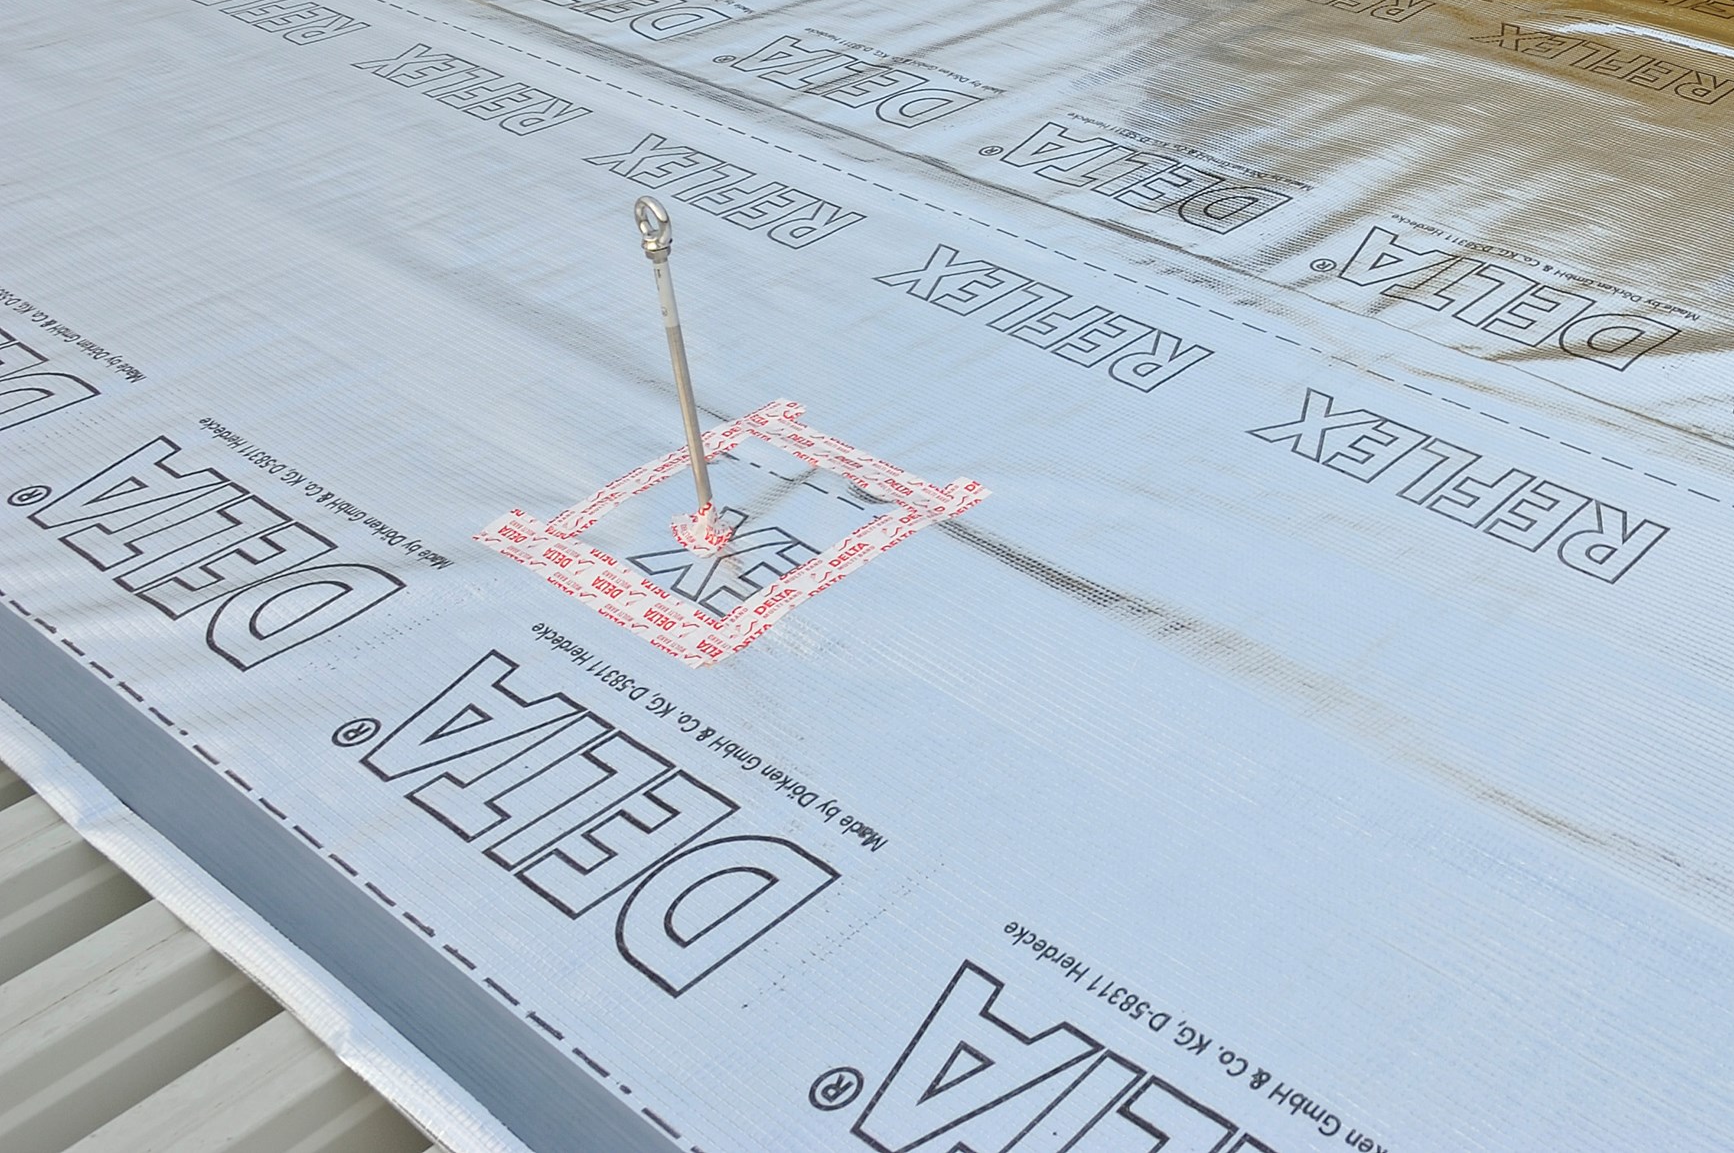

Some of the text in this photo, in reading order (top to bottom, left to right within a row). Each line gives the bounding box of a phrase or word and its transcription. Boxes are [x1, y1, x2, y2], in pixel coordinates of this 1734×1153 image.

[351, 43, 593, 136] REFLEX
[583, 133, 867, 249] REFLEX
[1391, 214, 1444, 237] Herdecke
[1554, 268, 1595, 288] GmbH
[1643, 297, 1663, 310] by
[1662, 303, 1701, 323] Made
[873, 244, 1214, 392] REFLEX
[104, 355, 123, 369] by
[199, 417, 248, 449] Herdecke
[305, 481, 324, 497] Co.
[1246, 387, 1671, 584] REFLEX
[316, 492, 335, 503] &
[325, 498, 367, 522] GmbH
[363, 517, 407, 546] Dörken
[498, 526, 528, 543] DELTA
[401, 539, 422, 555] by
[542, 548, 573, 568] DELTA
[829, 543, 869, 567] DELTA
[417, 550, 455, 570] Made
[591, 576, 624, 599] DELTA
[754, 588, 797, 615] DELTA
[643, 608, 677, 631] DELTA
[531, 622, 594, 666] Herdecke
[696, 639, 723, 658] ELTA
[646, 692, 677, 719] KG,
[677, 711, 701, 733] Co.
[696, 726, 716, 742] &
[707, 735, 762, 771] GmbH
[761, 764, 819, 808] Dörken
[815, 799, 842, 824] by
[839, 815, 889, 852] Made
[1003, 921, 1342, 1138] GmbH & Co. KG, D-58311 Herdecke
